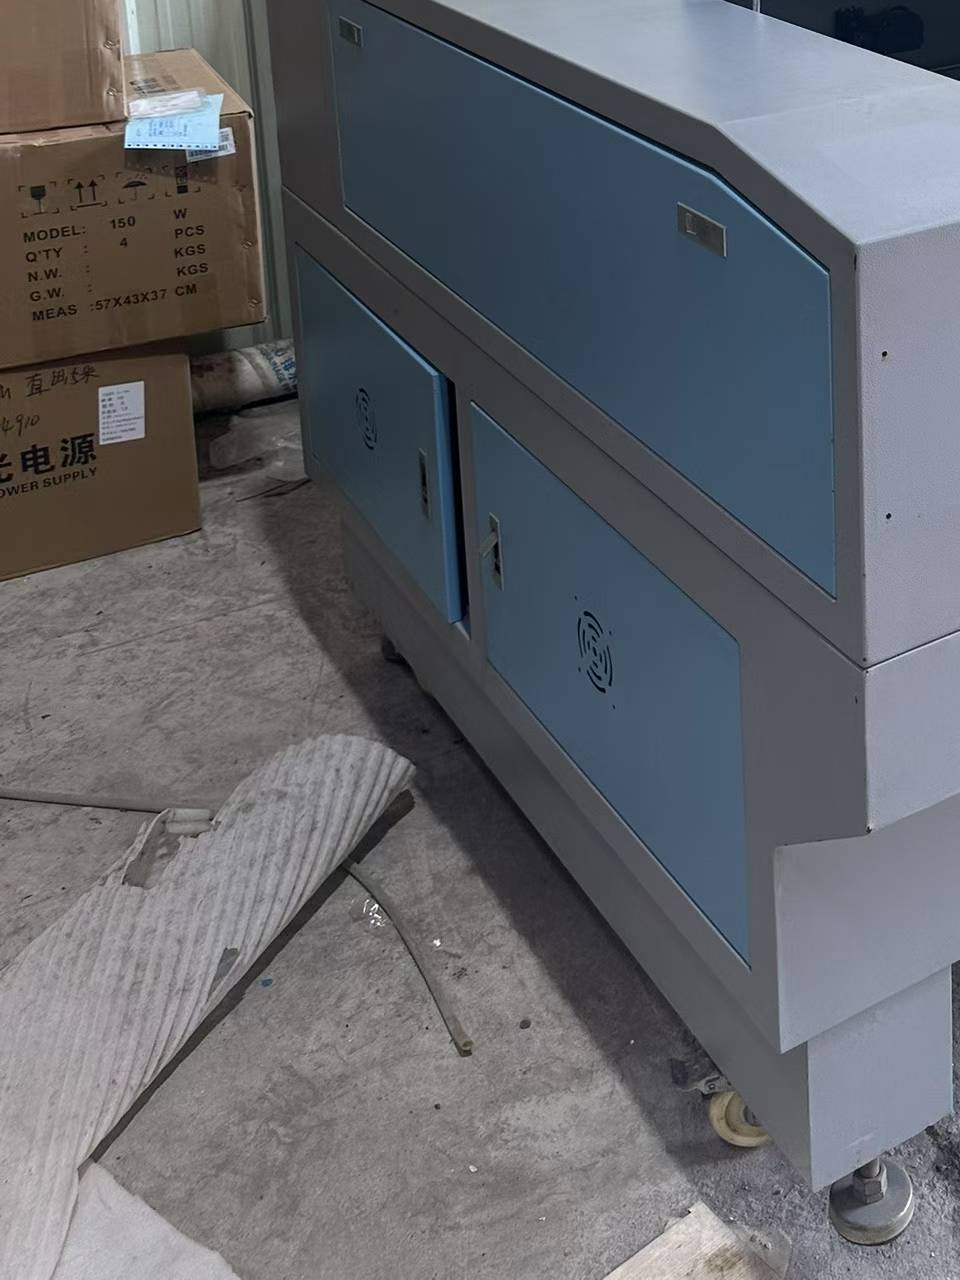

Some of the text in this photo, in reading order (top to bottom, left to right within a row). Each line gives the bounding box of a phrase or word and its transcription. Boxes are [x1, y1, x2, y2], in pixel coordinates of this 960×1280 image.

[23, 208, 187, 243] MODEL: 150 W
[25, 247, 63, 263] Q'TY
[119, 237, 128, 249] 4
[174, 225, 205, 239] PCS
[27, 267, 63, 282] N.W.
[174, 244, 206, 258] KGS
[30, 287, 65, 302] G.W.
[176, 263, 209, 278] KGS
[32, 304, 79, 321] MEAS
[175, 284, 197, 297] CM
[42, 467, 98, 489] SUPPLY
